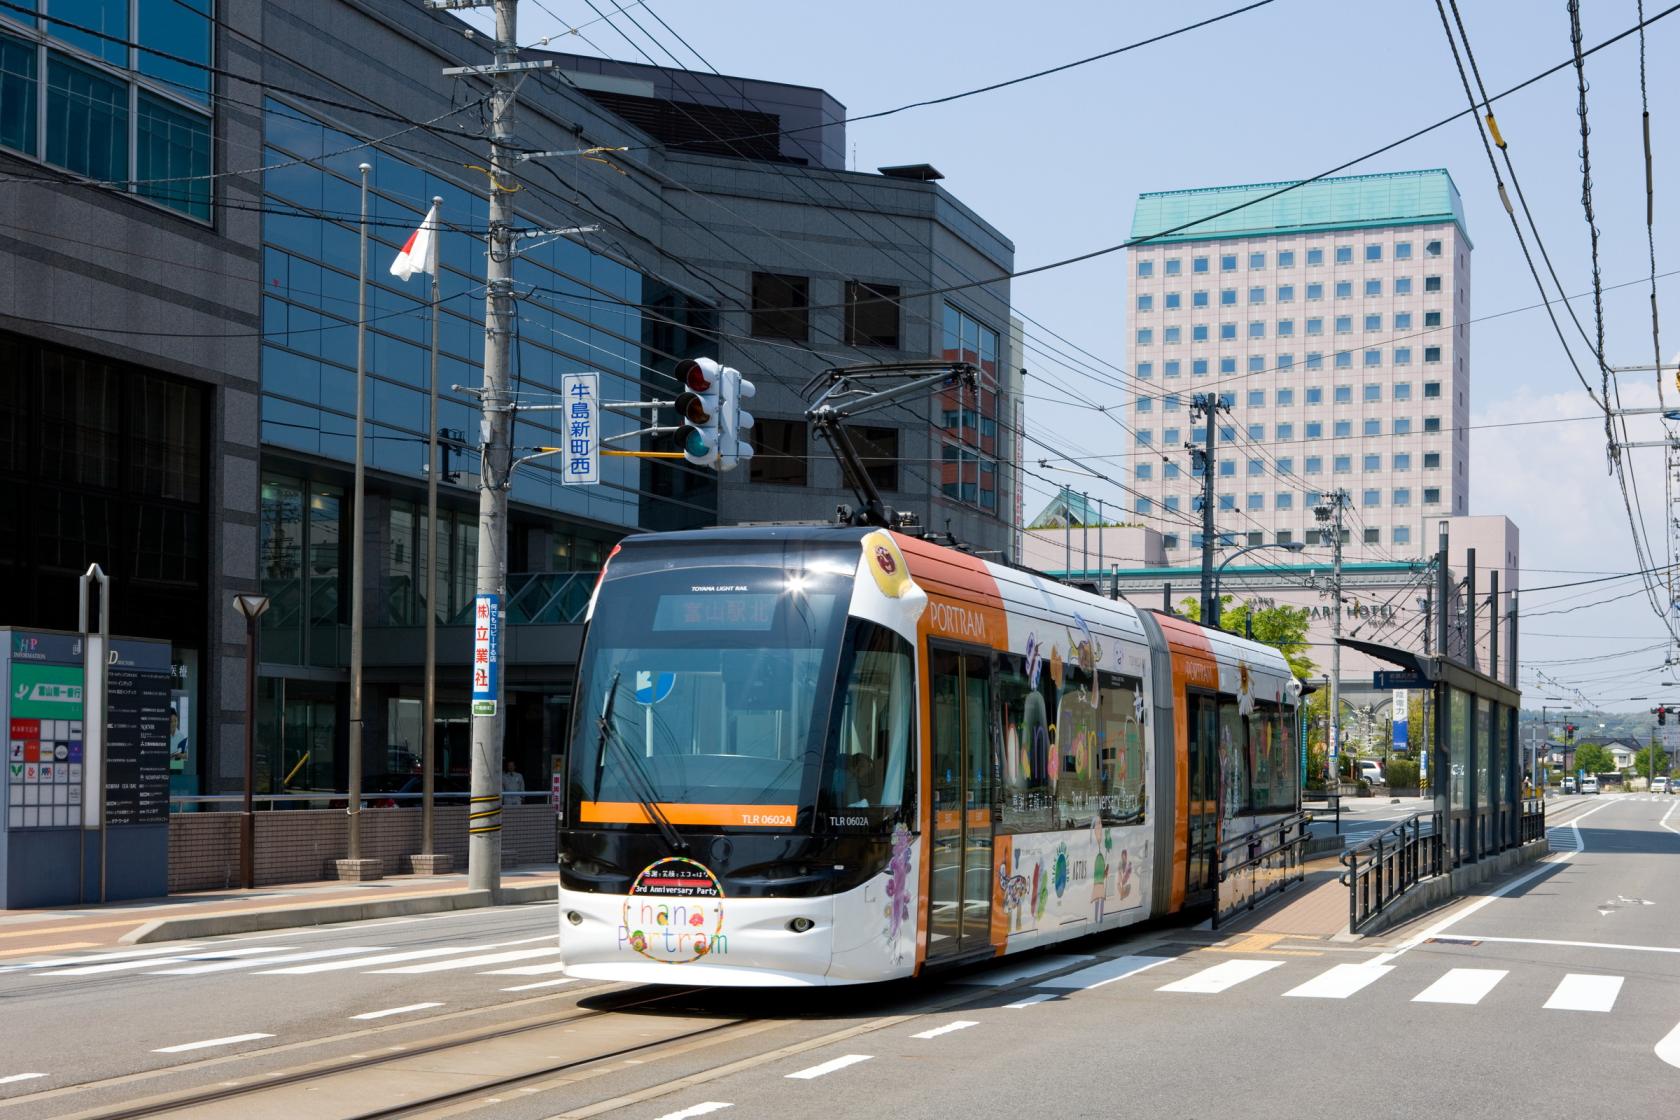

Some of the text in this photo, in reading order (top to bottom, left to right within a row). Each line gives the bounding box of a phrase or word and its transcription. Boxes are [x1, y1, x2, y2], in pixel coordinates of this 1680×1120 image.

[570, 383, 590, 475] 牛島新町西
[929, 601, 986, 639] PORTRAM
[1346, 604, 1397, 620] HOTEL
[1379, 673, 1384, 687] 1
[741, 814, 793, 825] TLR 0602A
[829, 816, 870, 826] TLR 0602A
[650, 886, 693, 896] Anniversary
[696, 887, 718, 896] Party
[640, 898, 705, 927] hana
[618, 925, 728, 954] Portram
